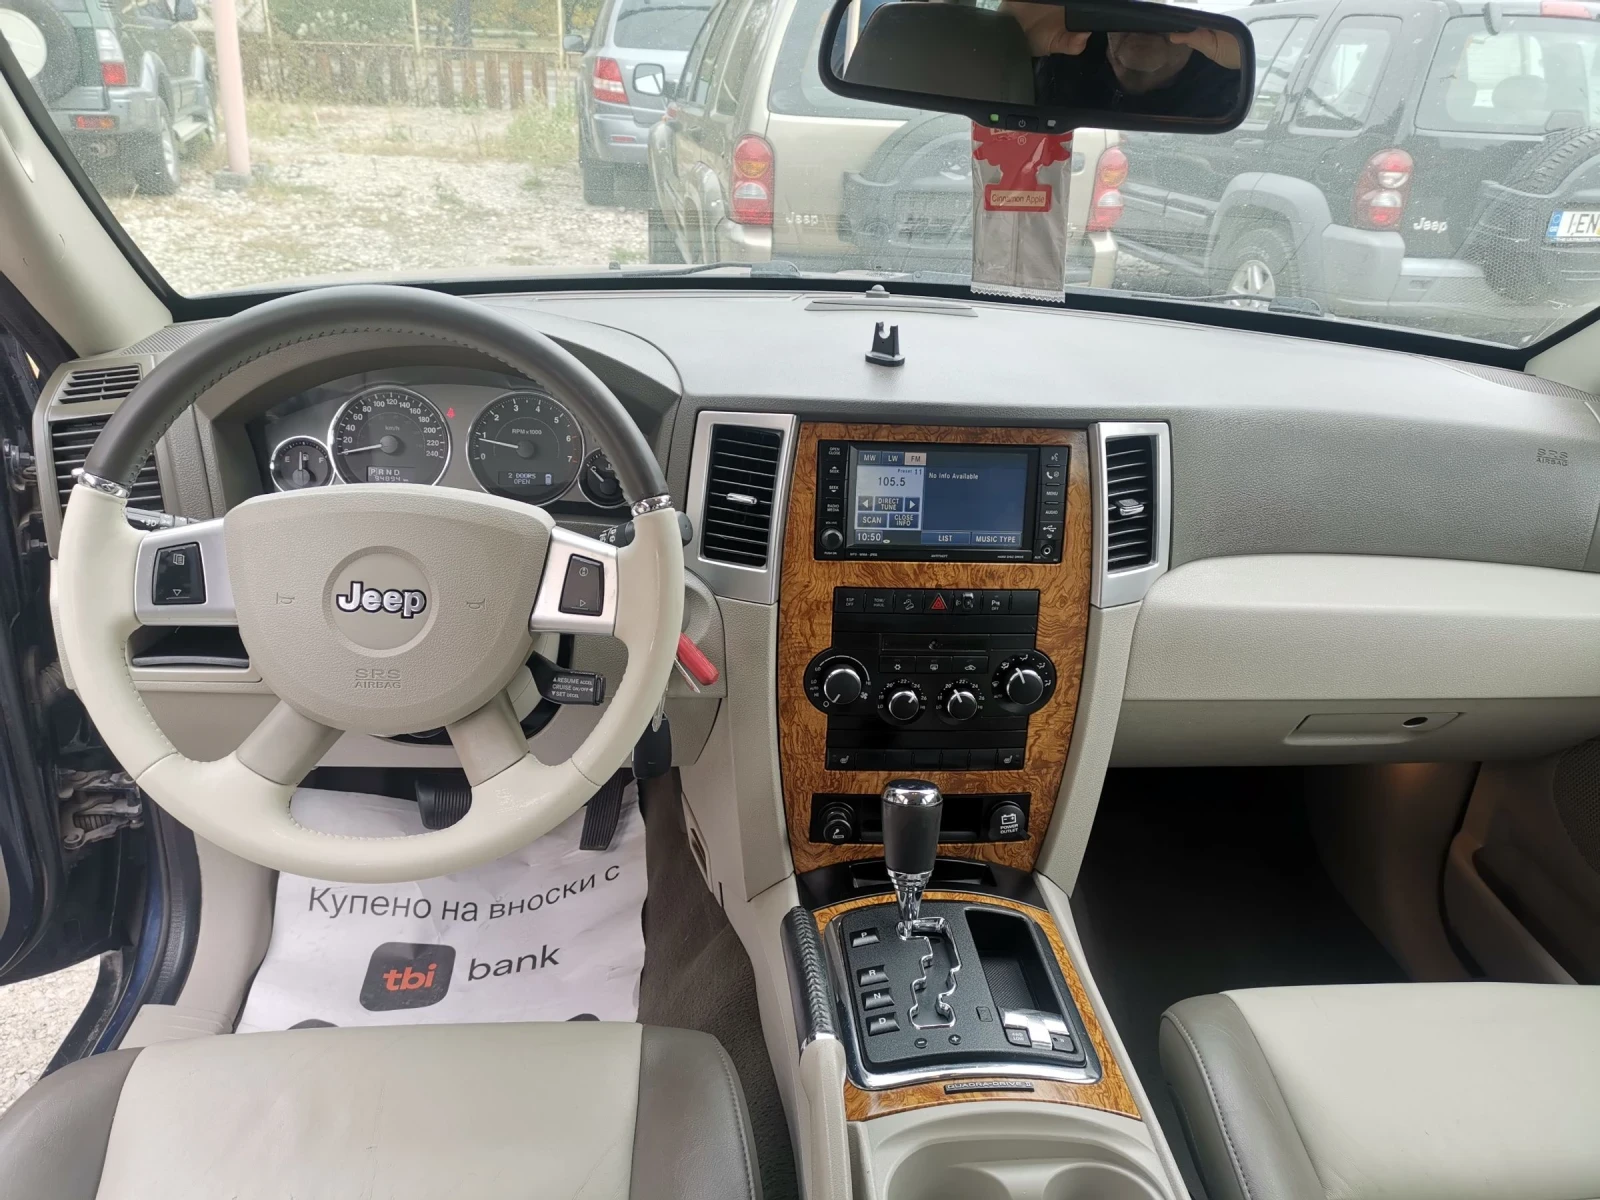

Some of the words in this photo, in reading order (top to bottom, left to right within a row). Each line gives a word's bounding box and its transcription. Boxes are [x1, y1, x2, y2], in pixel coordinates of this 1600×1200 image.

[992, 194, 1024, 204] Cinnamon
[1026, 195, 1045, 205] Apple
[786, 212, 819, 226] Jeep
[1413, 217, 1448, 233] Jeep
[878, 477, 906, 487] 105.5
[858, 533, 881, 541] 10:50
[336, 581, 426, 618] Jeep
[355, 668, 400, 679] SRS
[308, 886, 432, 919] Купено
[442, 900, 478, 922] на
[489, 872, 596, 920] вноски
[604, 864, 620, 881] с
[382, 963, 436, 991] tbi
[468, 944, 560, 982] bank
